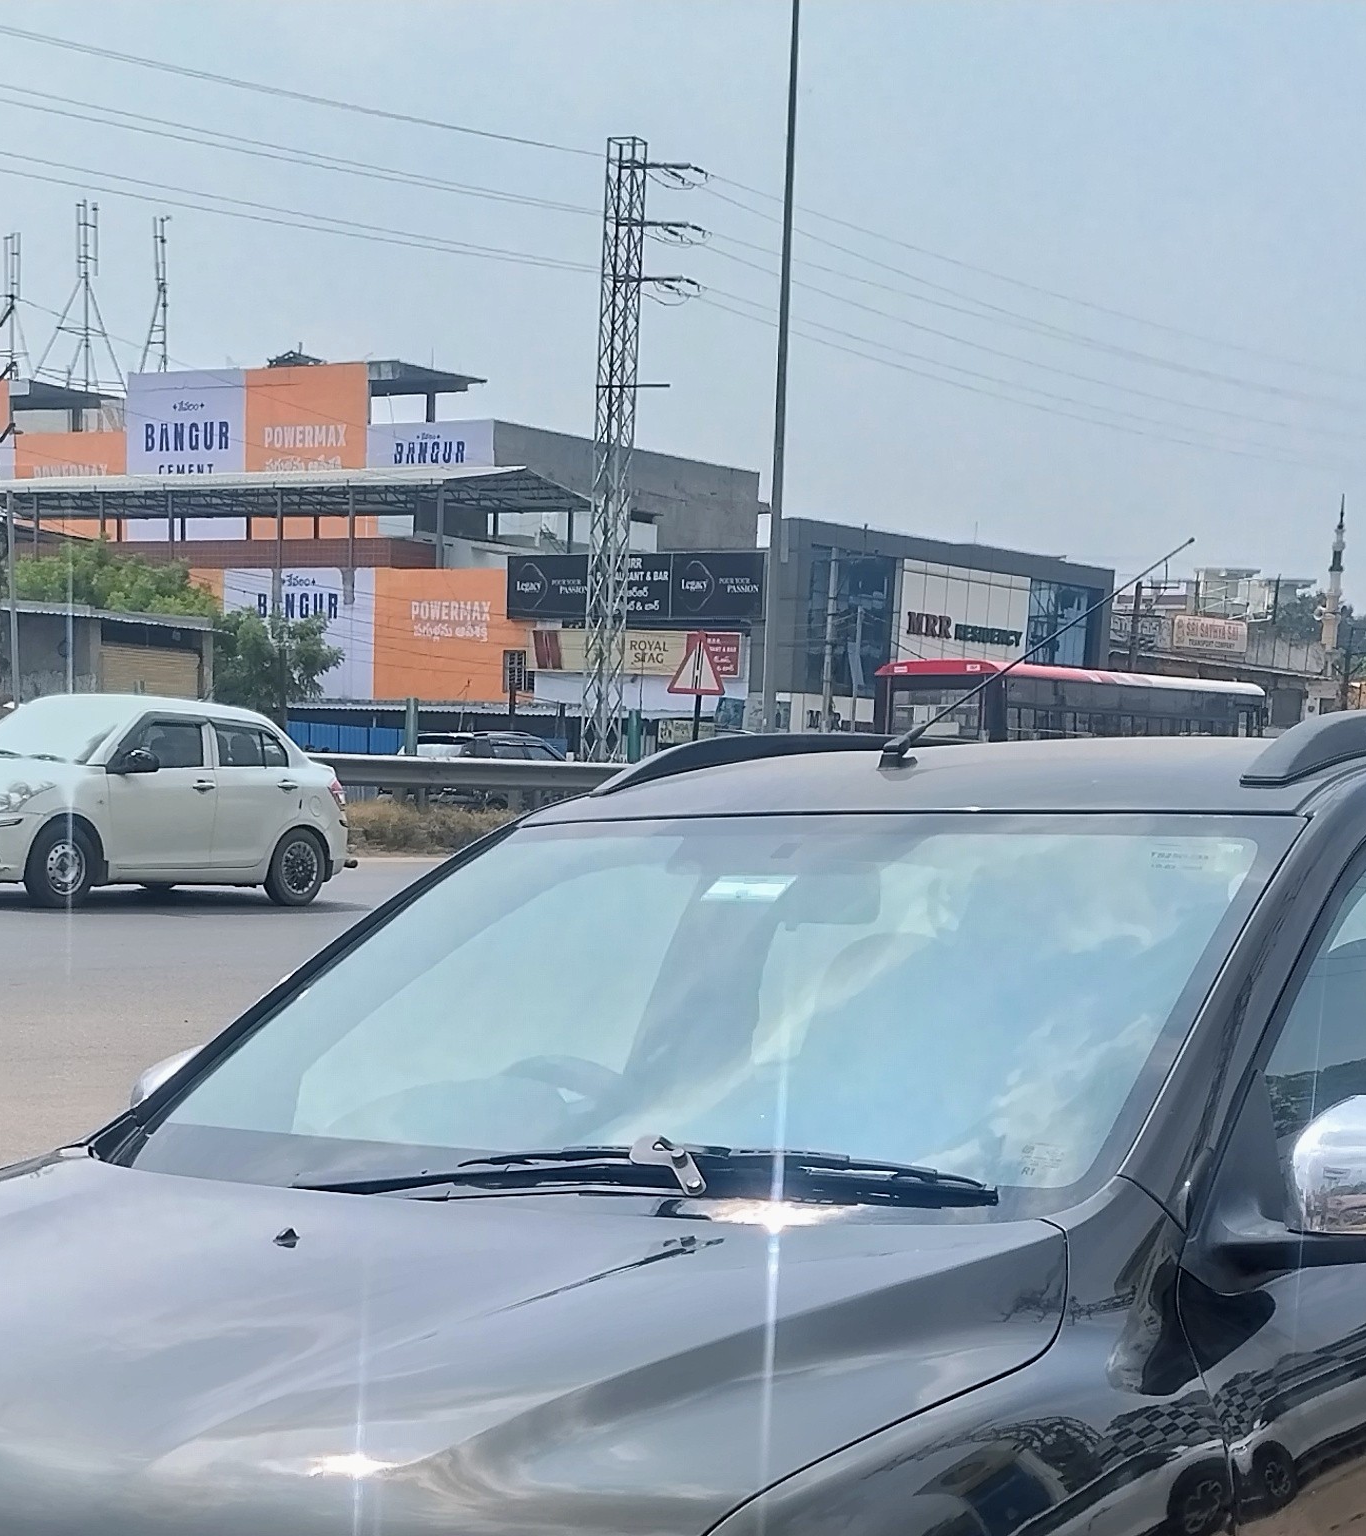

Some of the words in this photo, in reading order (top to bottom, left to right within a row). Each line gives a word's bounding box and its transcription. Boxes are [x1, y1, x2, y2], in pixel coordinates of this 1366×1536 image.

[144, 421, 229, 452] BANGUR
[264, 424, 347, 448] POWERMAX
[393, 441, 466, 464] BANGUR
[653, 571, 669, 581] BAR
[516, 580, 542, 594] Legacy
[681, 579, 708, 593] Legacy
[727, 585, 759, 594] PASSION
[257, 593, 338, 620] BNGUR
[411, 601, 491, 621] POWERMAX
[906, 611, 952, 639] MRR
[954, 623, 1023, 648] RESIDENCY
[629, 640, 669, 652] ROYAL
[634, 652, 665, 664] STAG
